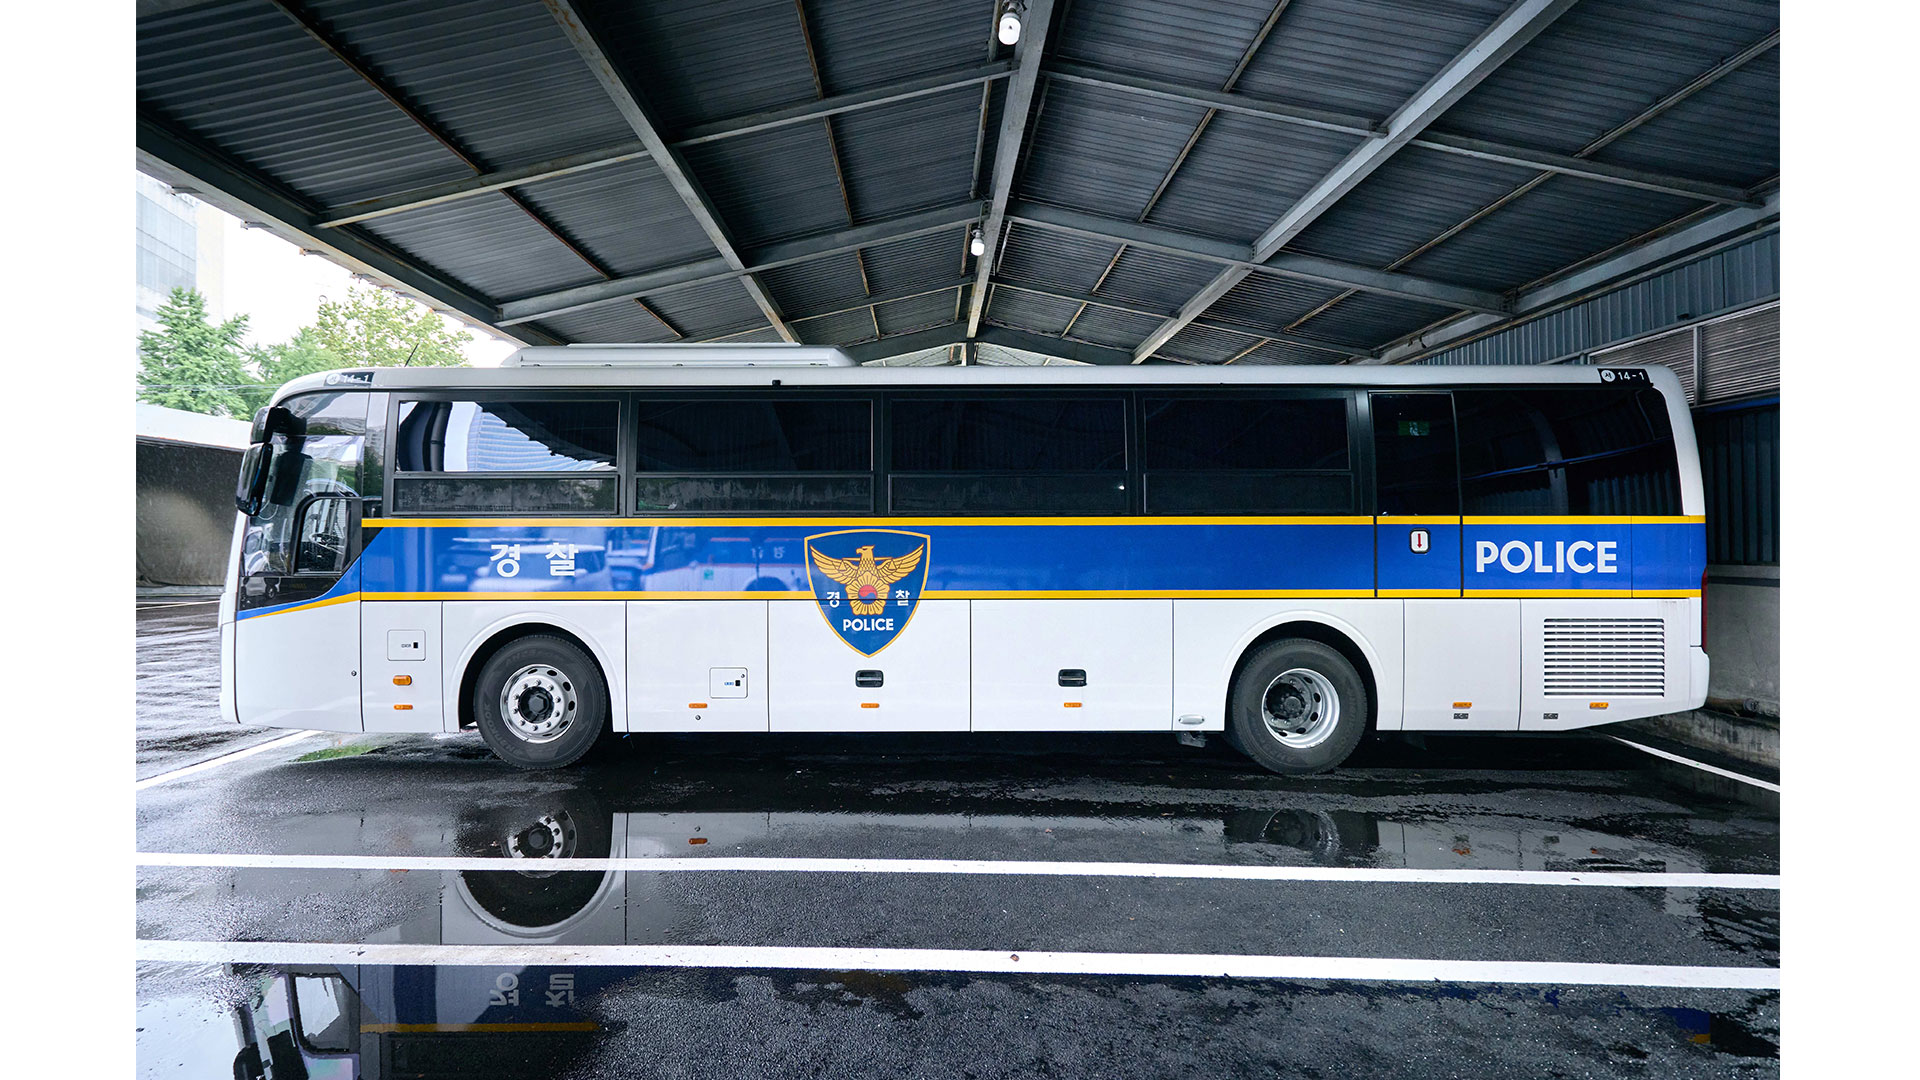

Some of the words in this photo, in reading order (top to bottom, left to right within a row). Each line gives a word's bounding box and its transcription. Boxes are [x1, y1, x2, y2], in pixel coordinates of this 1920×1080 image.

[1617, 371, 1645, 381] 14-1
[490, 543, 521, 578] 경
[545, 542, 579, 577] 찰
[1476, 540, 1618, 574] POLICE
[826, 591, 840, 608] 경
[895, 589, 910, 606] 찰
[843, 618, 894, 631] POLICE
